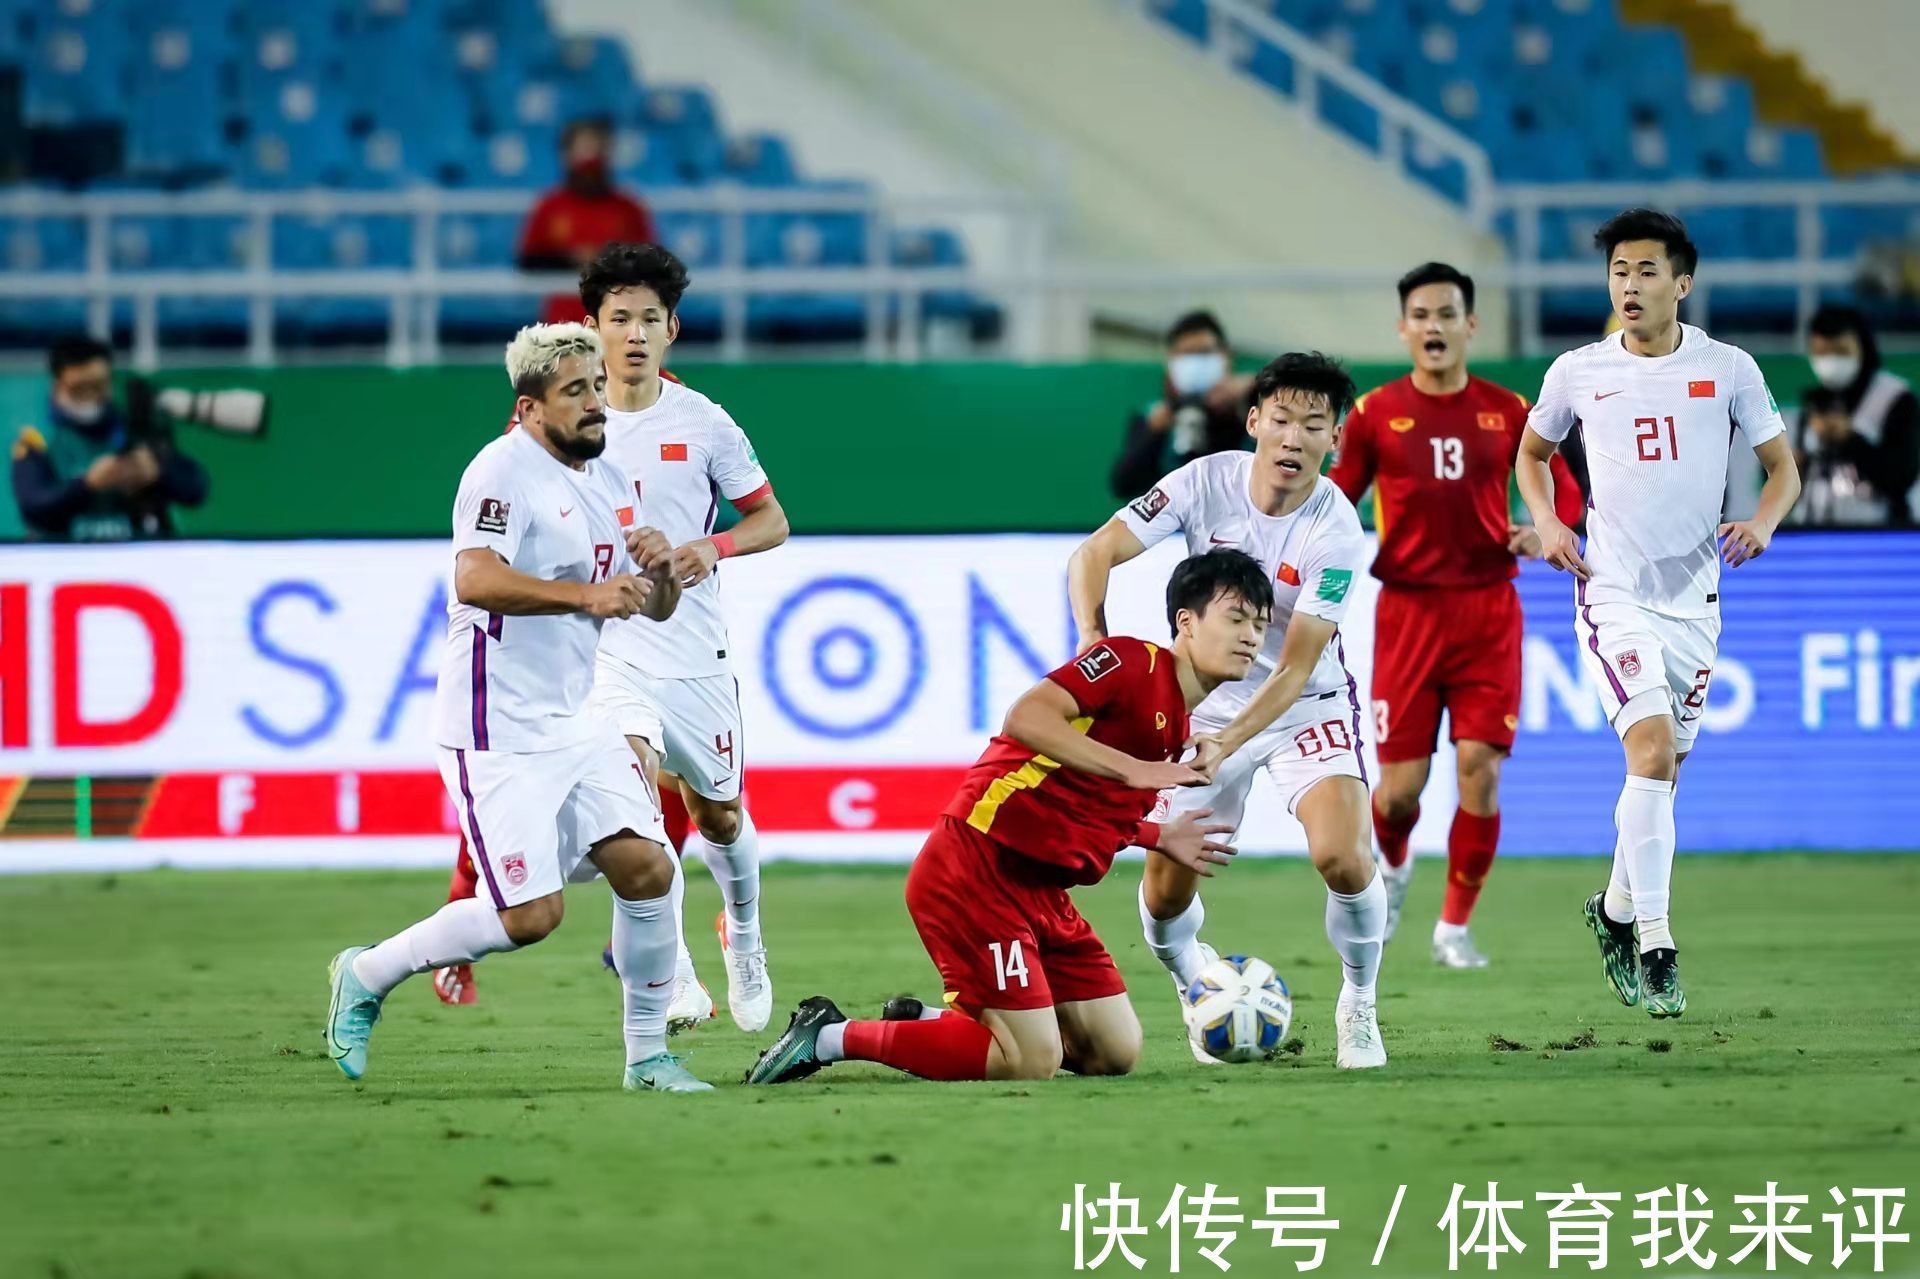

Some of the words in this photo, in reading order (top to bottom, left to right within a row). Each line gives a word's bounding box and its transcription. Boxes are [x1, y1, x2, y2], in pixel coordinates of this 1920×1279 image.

[1429, 437, 1465, 480] 13
[1634, 416, 1678, 461] 21
[715, 730, 734, 770] 4
[1293, 719, 1352, 758] 20
[988, 939, 1030, 991] 14
